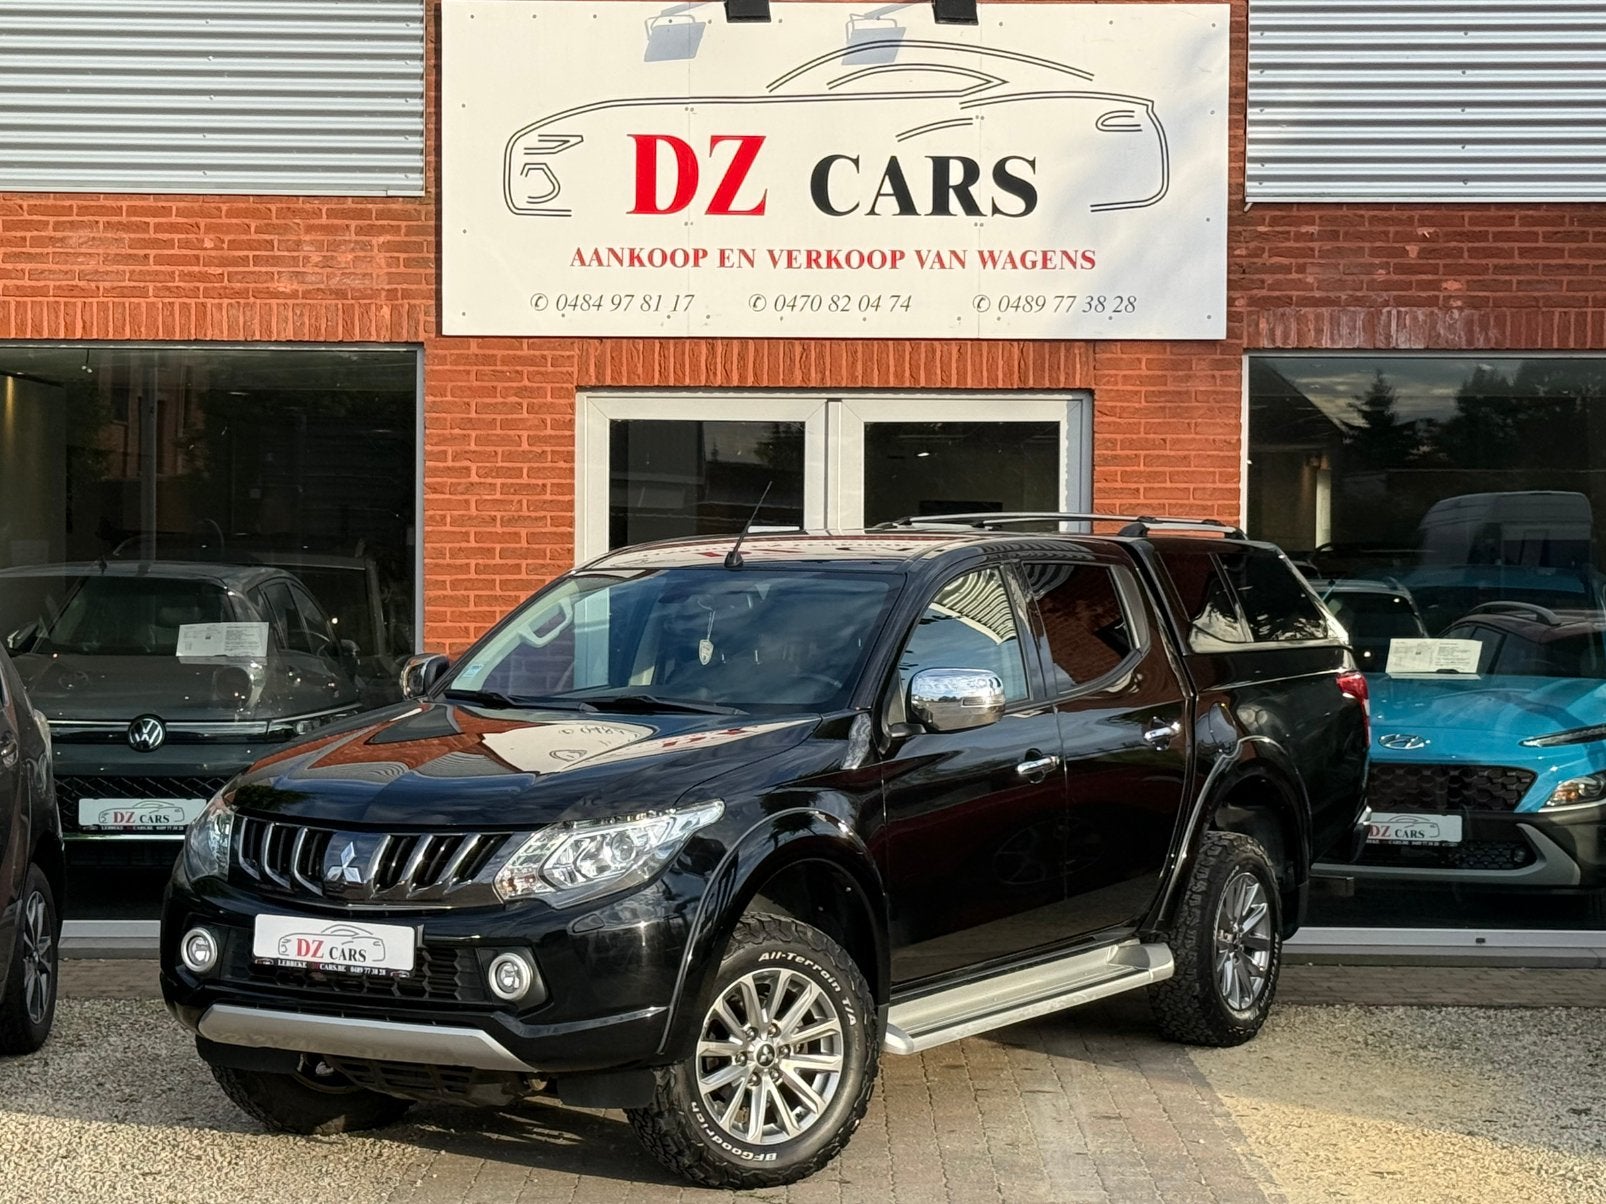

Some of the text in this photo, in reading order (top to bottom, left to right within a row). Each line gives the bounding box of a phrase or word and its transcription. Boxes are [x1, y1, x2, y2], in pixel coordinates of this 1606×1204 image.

[625, 133, 1039, 219] DZ CARS
[569, 246, 1097, 271] AANKOOP EN VERKOOP VAN WAGENS
[555, 293, 695, 313] 0484 97 81 17
[774, 293, 912, 314] 0470 82 04 74
[997, 294, 1137, 314] 0489 77 38 28
[113, 811, 170, 824] DZ CARS
[1368, 825, 1425, 839] DZ CARS
[296, 938, 367, 963] DZ CARS
[758, 951, 857, 1026] All-Terrain T/A
[690, 1101, 778, 1162] BFGoodrich
